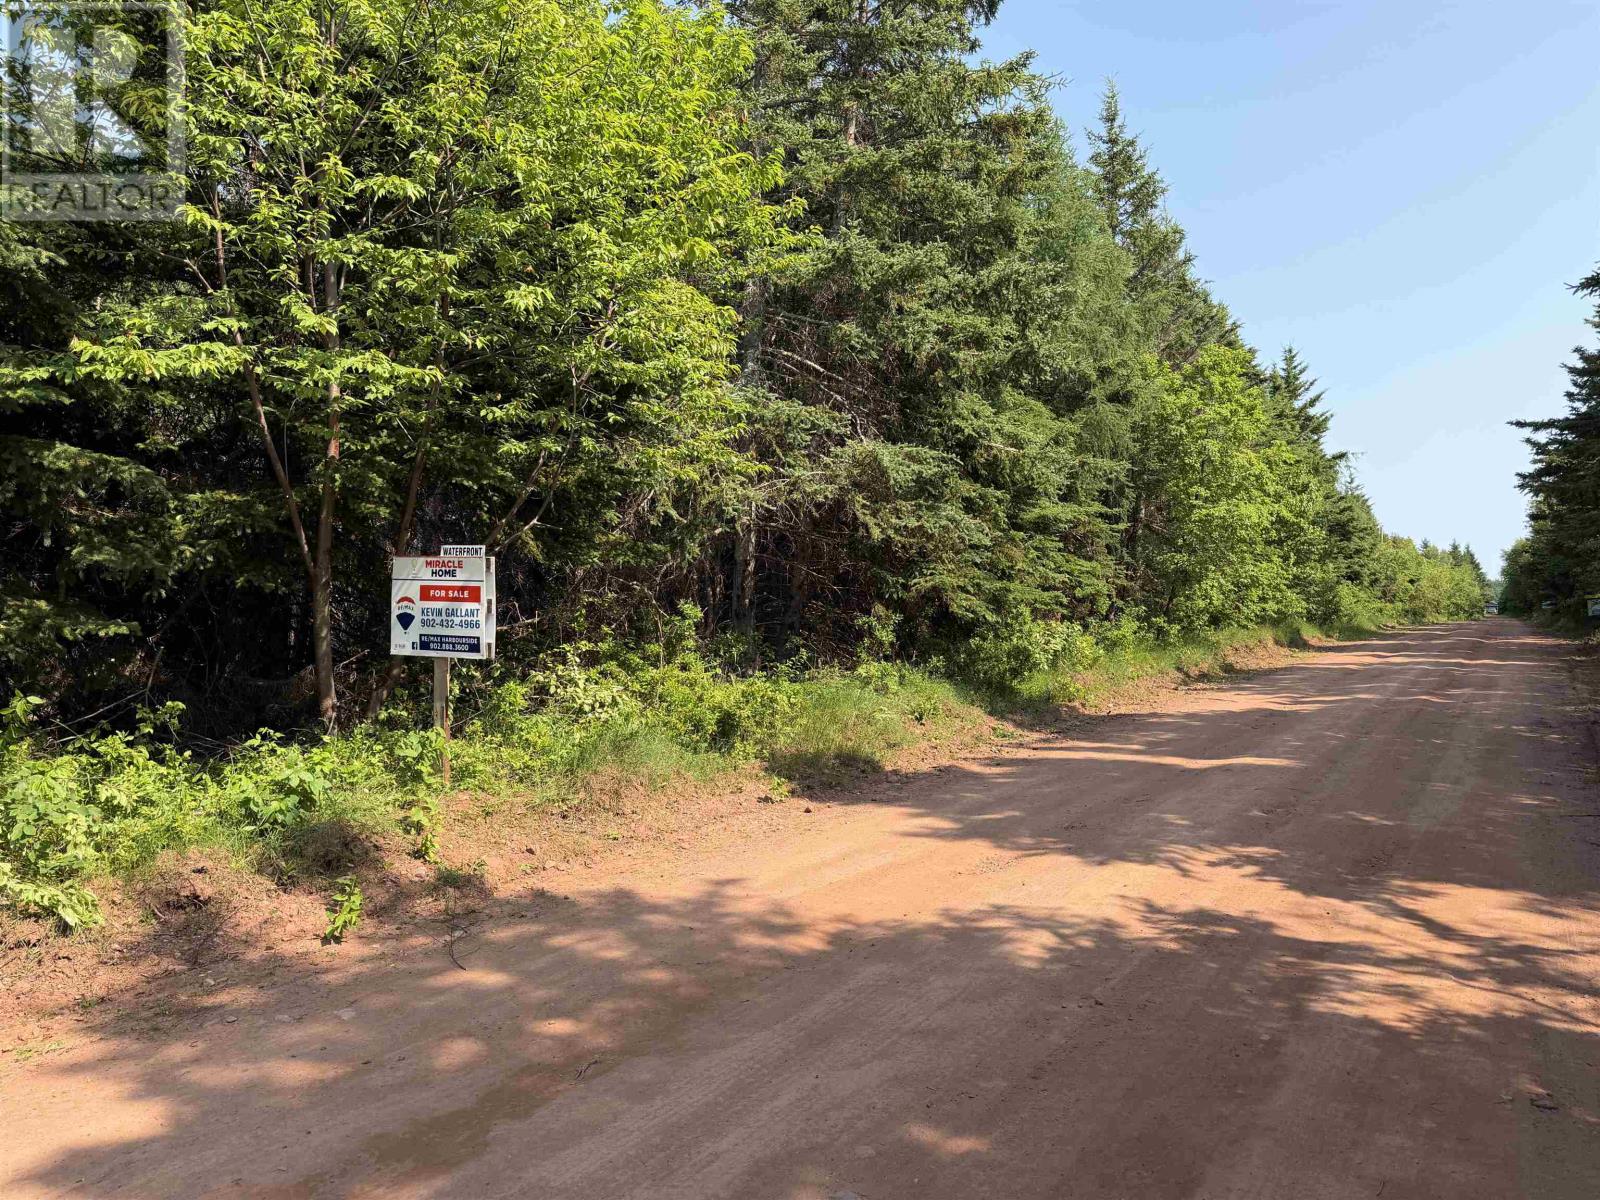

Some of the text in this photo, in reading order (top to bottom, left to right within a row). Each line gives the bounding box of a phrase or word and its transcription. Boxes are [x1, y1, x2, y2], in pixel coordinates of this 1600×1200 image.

[442, 547, 483, 556] WATERFRONT
[425, 560, 464, 569] MIRACLE
[431, 569, 457, 578] HOME
[448, 590, 469, 598] SALE
[421, 607, 480, 618] KEVIN GALLANT
[421, 619, 480, 629] 902-432-4966
[429, 643, 469, 651] 902.888.3600
